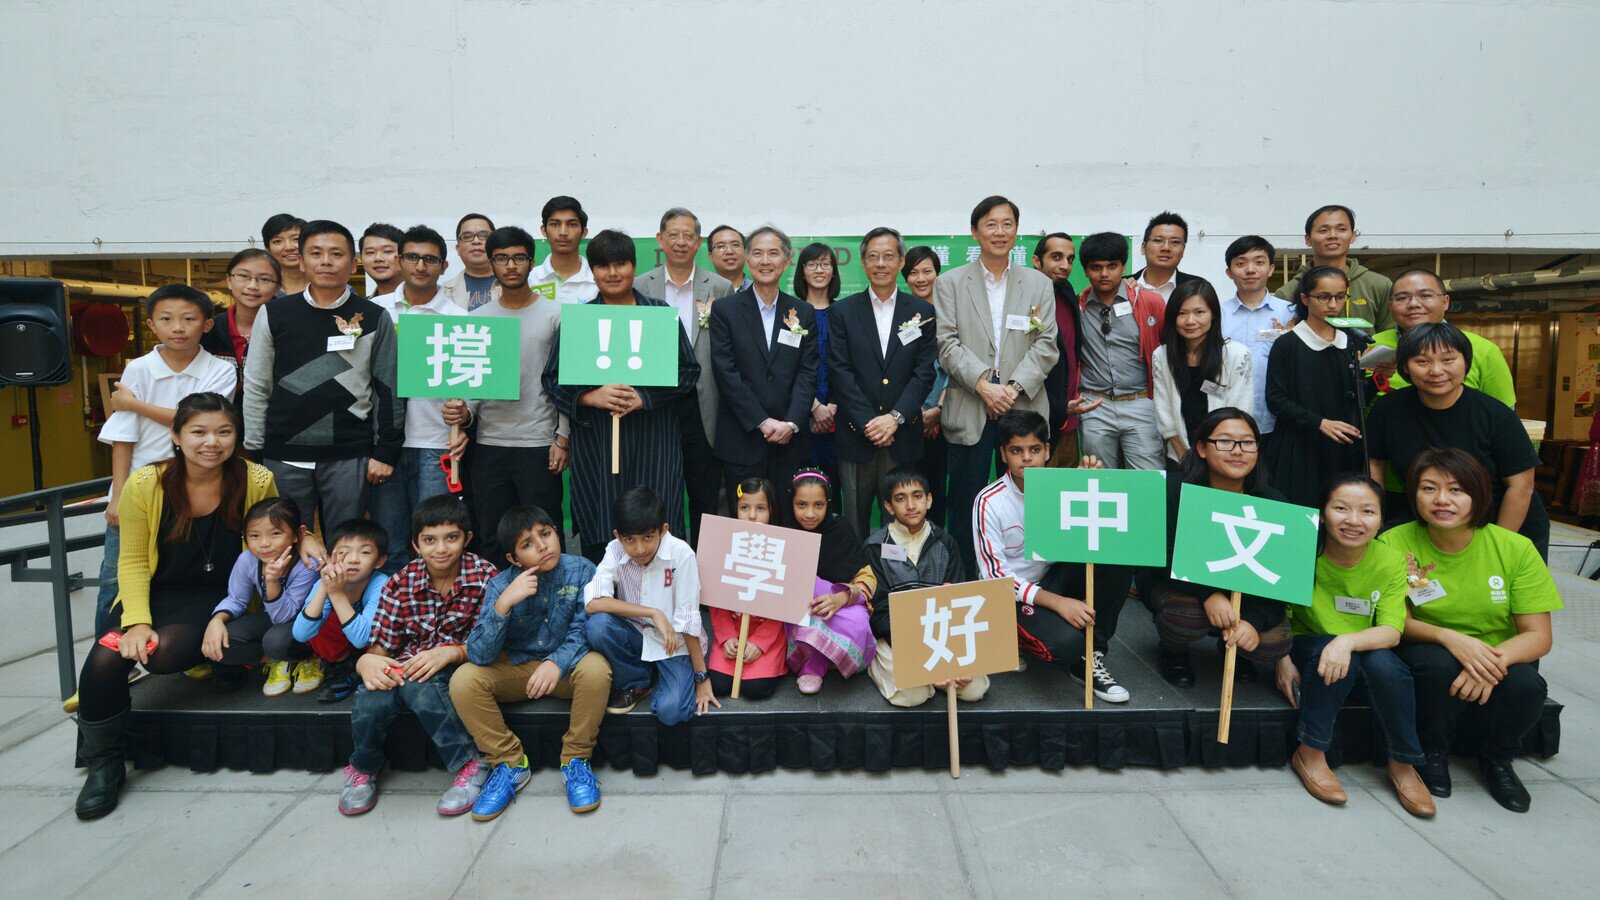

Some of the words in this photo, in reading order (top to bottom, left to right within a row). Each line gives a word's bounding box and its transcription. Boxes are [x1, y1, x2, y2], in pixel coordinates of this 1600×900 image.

[597, 319, 643, 370] !!
[1060, 479, 1128, 550] 中
[1206, 506, 1285, 584] 文
[720, 531, 787, 601] 學
[921, 595, 989, 672] 好
